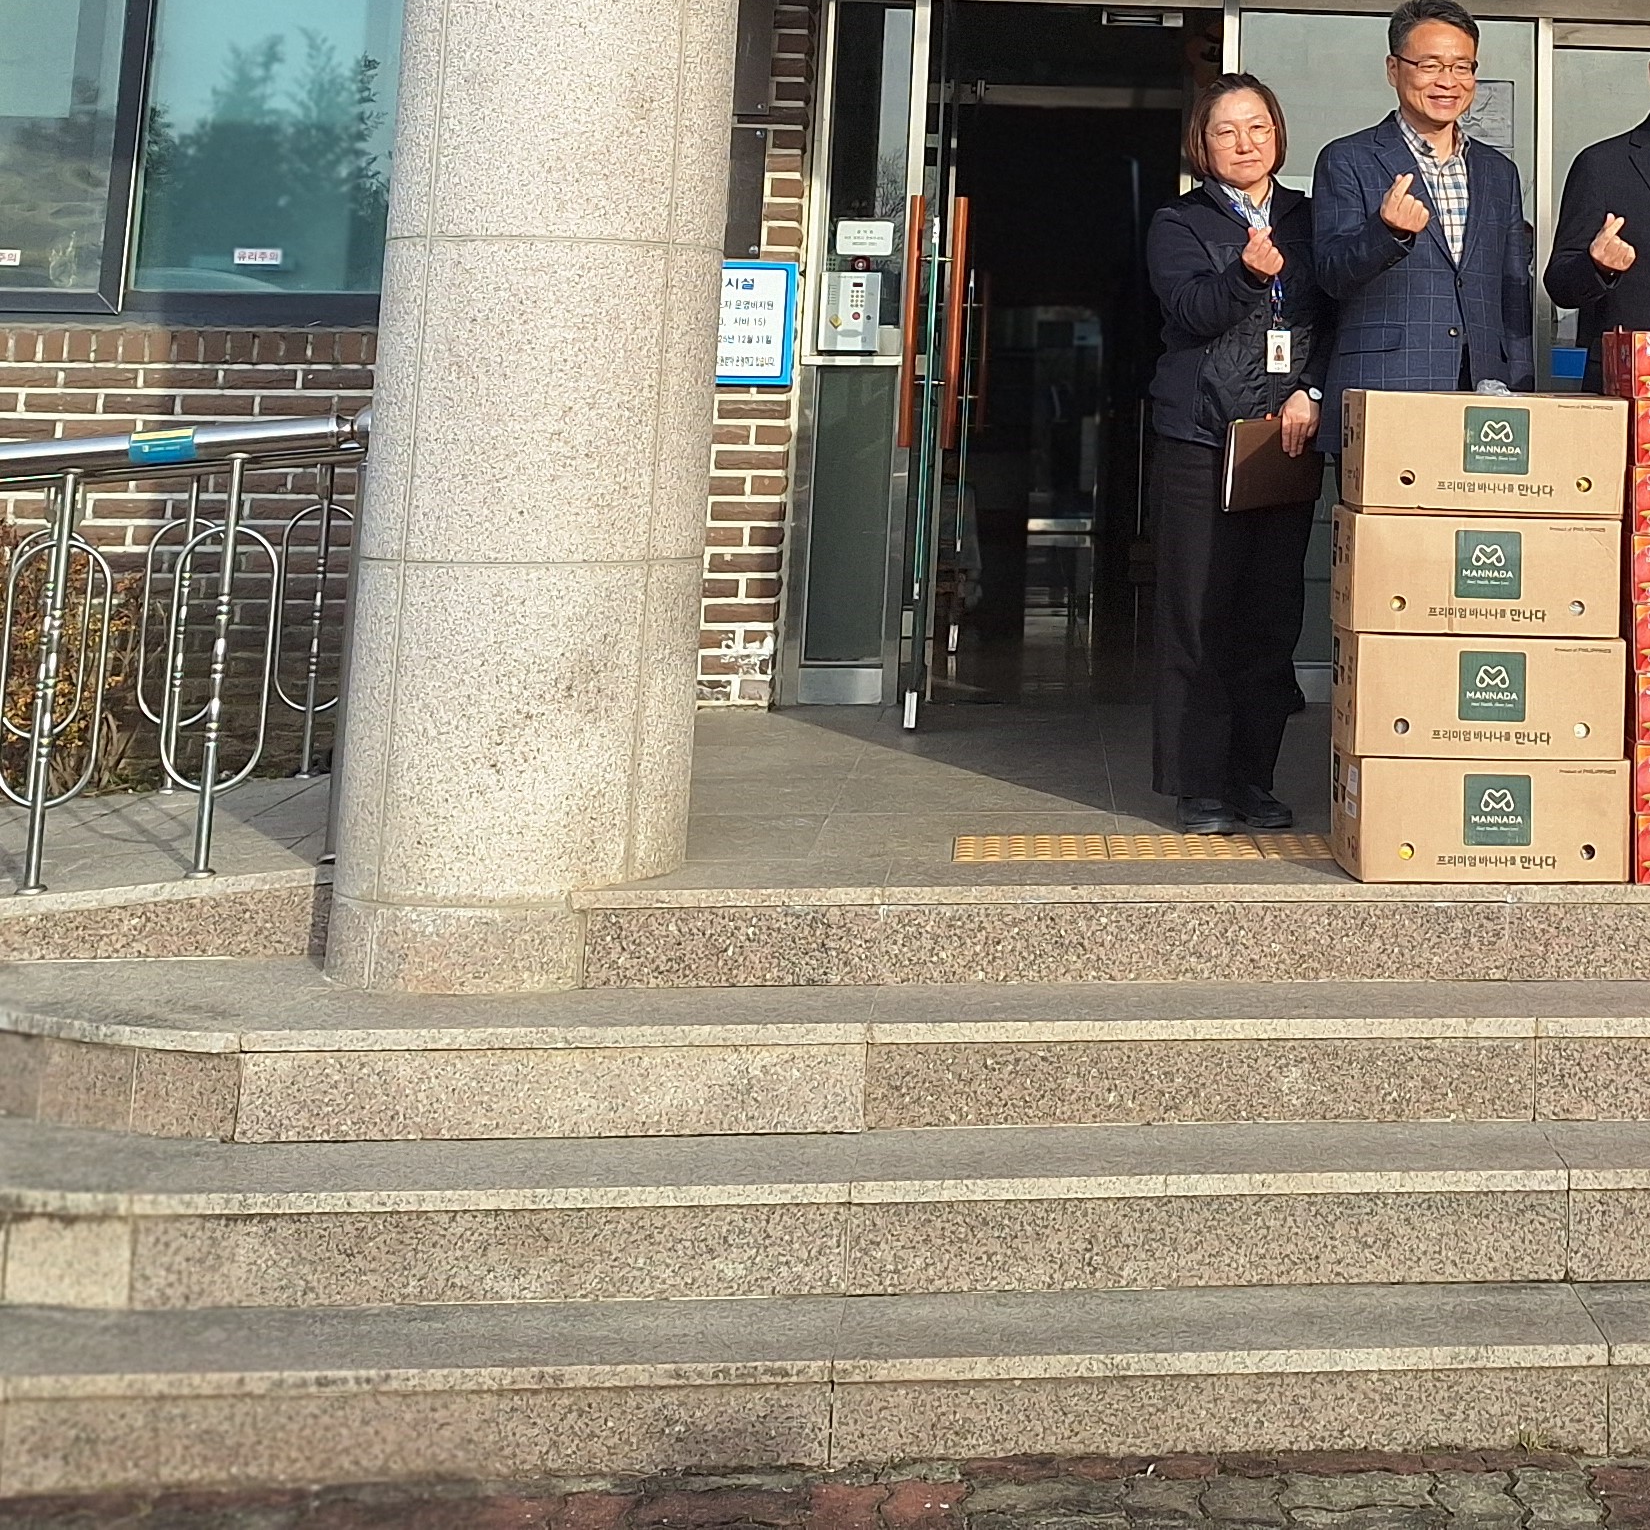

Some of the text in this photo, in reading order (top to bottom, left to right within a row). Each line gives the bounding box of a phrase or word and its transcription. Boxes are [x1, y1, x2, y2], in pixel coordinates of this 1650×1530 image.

[237, 251, 278, 262] 유리주의
[725, 278, 755, 290] 시설
[735, 299, 774, 310] 운영비지원
[754, 317, 766, 327] 15)
[1470, 445, 1521, 455] MANNADA
[1437, 480, 1555, 497] 프리미엄 바나나를 만나다
[1462, 569, 1513, 579] MANNADA
[1428, 606, 1547, 622] 프리미엄 바나나를 만나다
[1466, 690, 1518, 701] MANNADA
[1431, 729, 1551, 746] 프리미엄 바나나를 만나다
[1471, 815, 1523, 824] MANNADA
[1436, 855, 1557, 870] 프리미엄 바나나를 만나다
